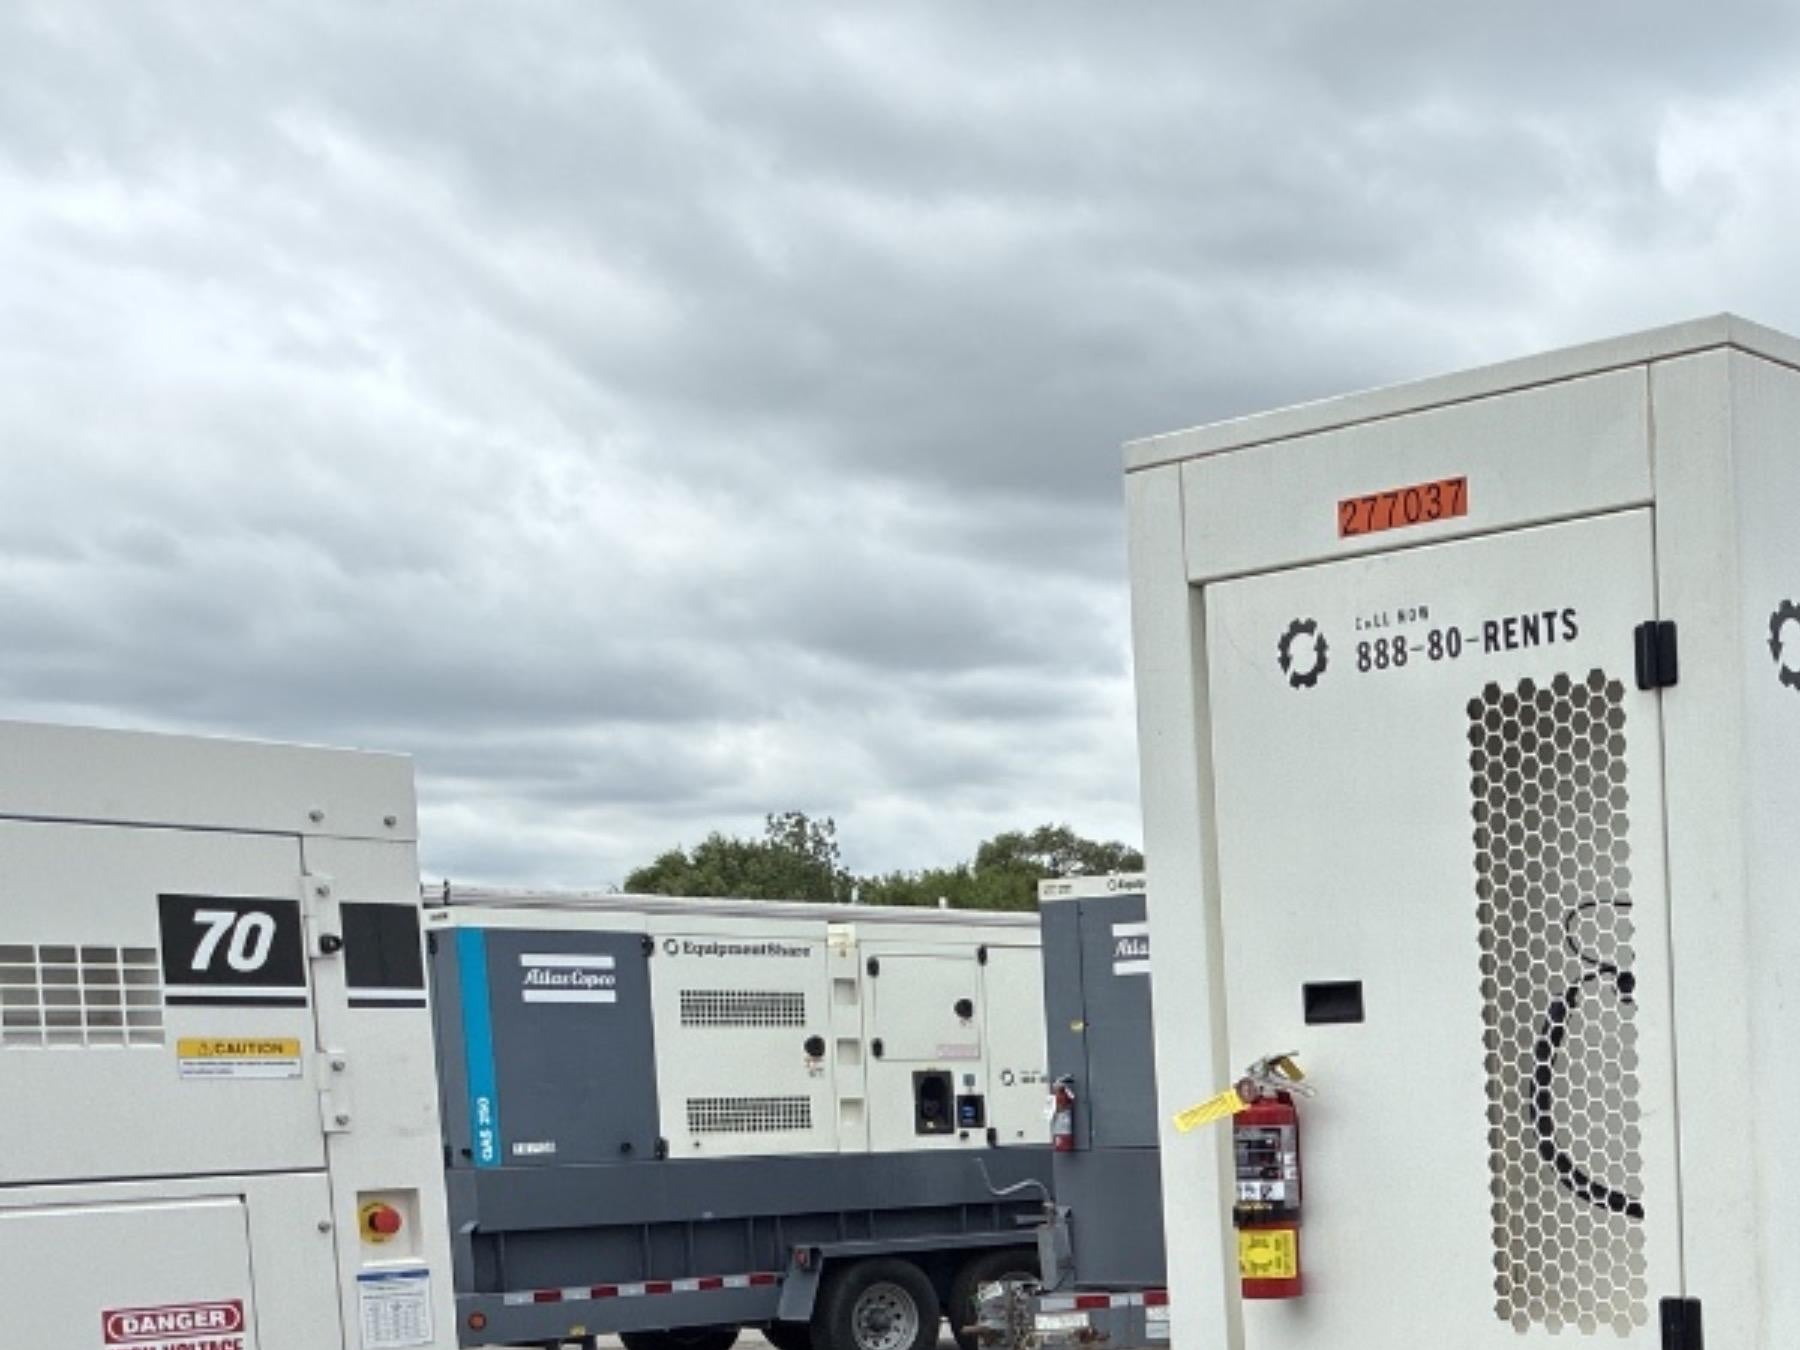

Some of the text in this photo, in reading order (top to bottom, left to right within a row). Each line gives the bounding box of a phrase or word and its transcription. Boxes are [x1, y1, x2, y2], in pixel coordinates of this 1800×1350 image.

[1342, 479, 1463, 538] 277037
[1356, 607, 1579, 673] 888-80-RENTS
[191, 910, 277, 973] 70
[215, 1042, 283, 1054] CAUTION
[121, 1310, 227, 1335] DANGER
